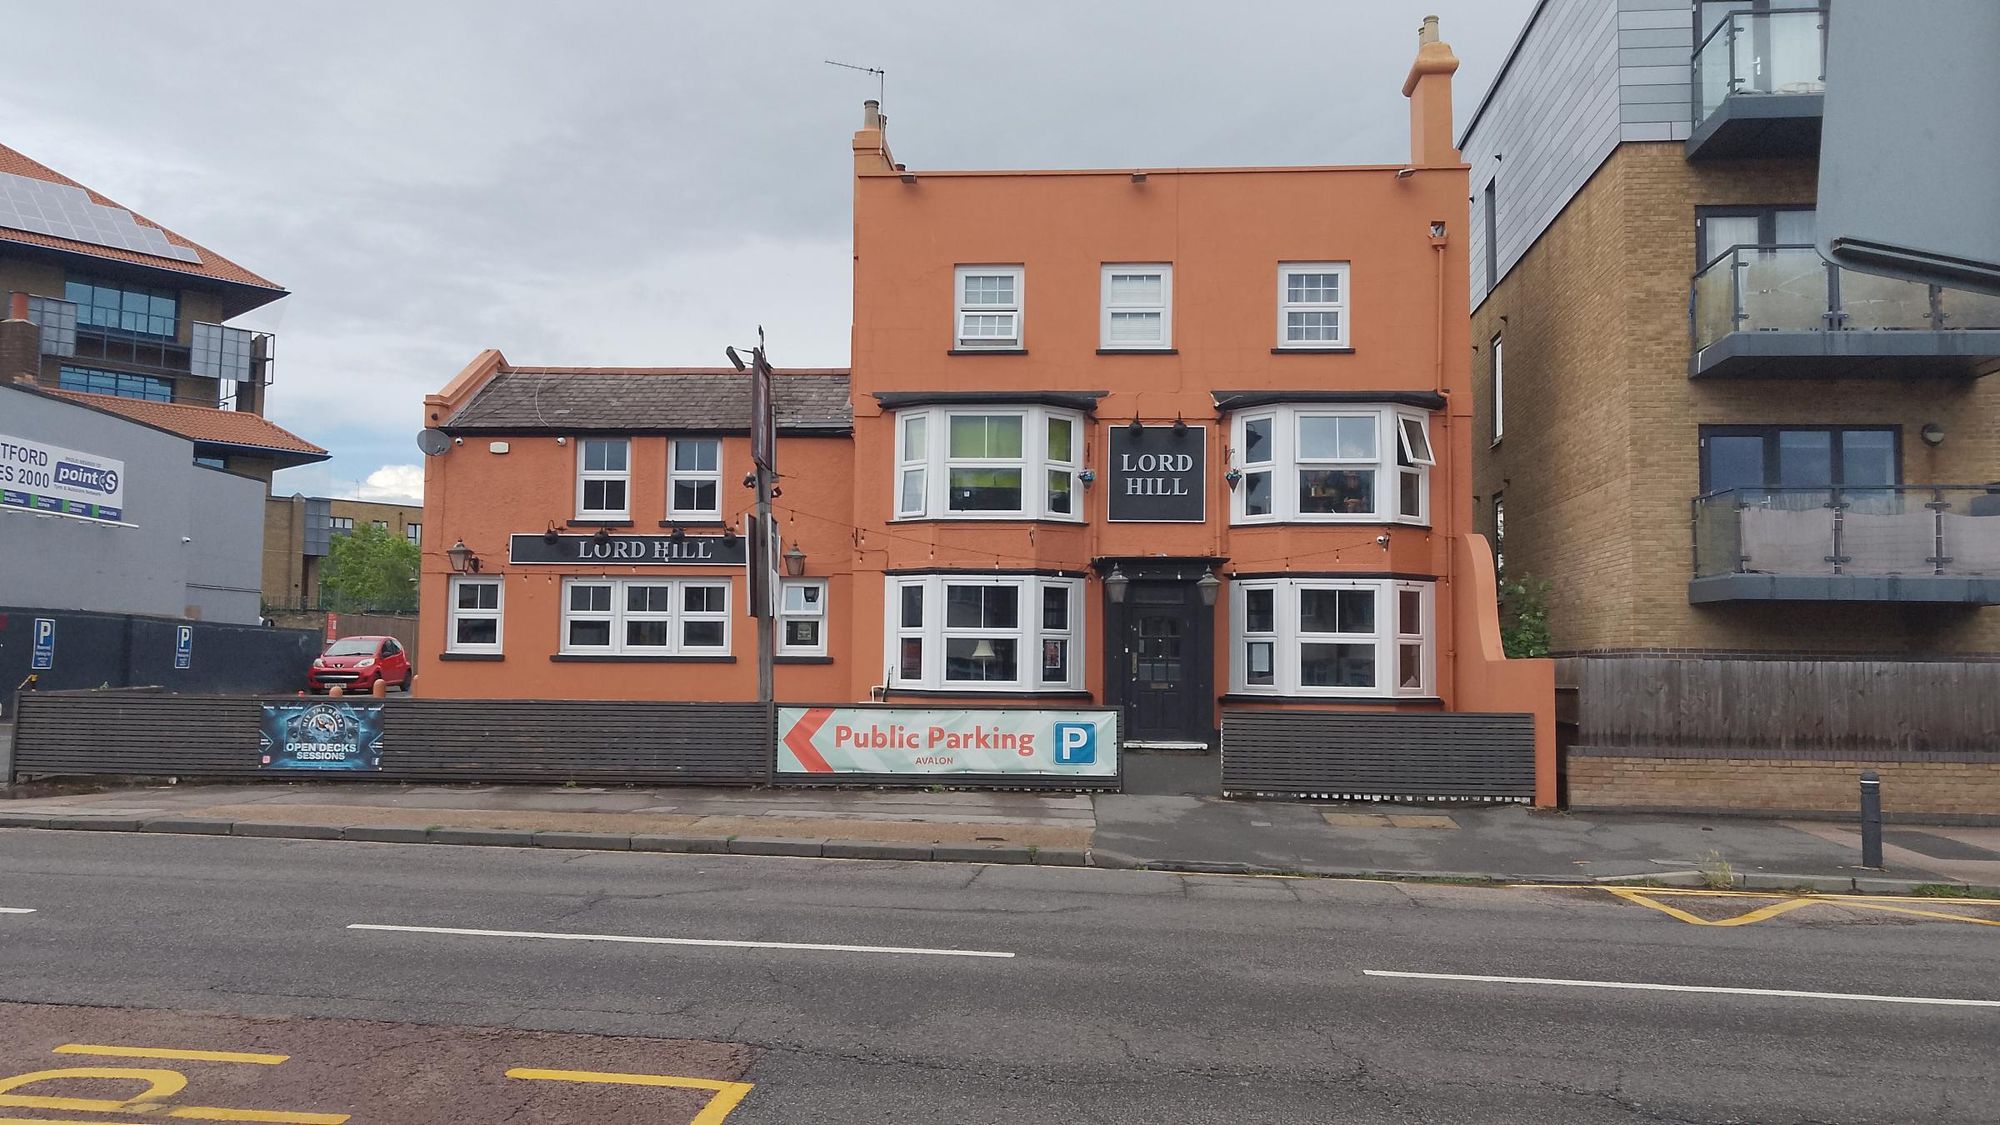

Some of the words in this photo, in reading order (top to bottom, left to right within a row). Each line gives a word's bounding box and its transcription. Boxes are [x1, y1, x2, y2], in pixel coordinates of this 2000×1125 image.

[1, 443, 48, 467] TFORD
[1121, 454, 1192, 472] LORD
[18, 469, 49, 488] 2000
[59, 467, 98, 485] point
[1125, 477, 1188, 496] HILL
[578, 541, 646, 559] LORD
[652, 541, 712, 559] HILL
[40, 622, 50, 645] P
[180, 629, 190, 647] P
[286, 743, 319, 752] OPEN
[320, 743, 357, 752] DECKS
[835, 725, 920, 749] Public
[928, 724, 1035, 756] Parking
[1062, 727, 1088, 759] P
[296, 751, 345, 760] SESSIONS
[915, 756, 953, 765] AVALON
